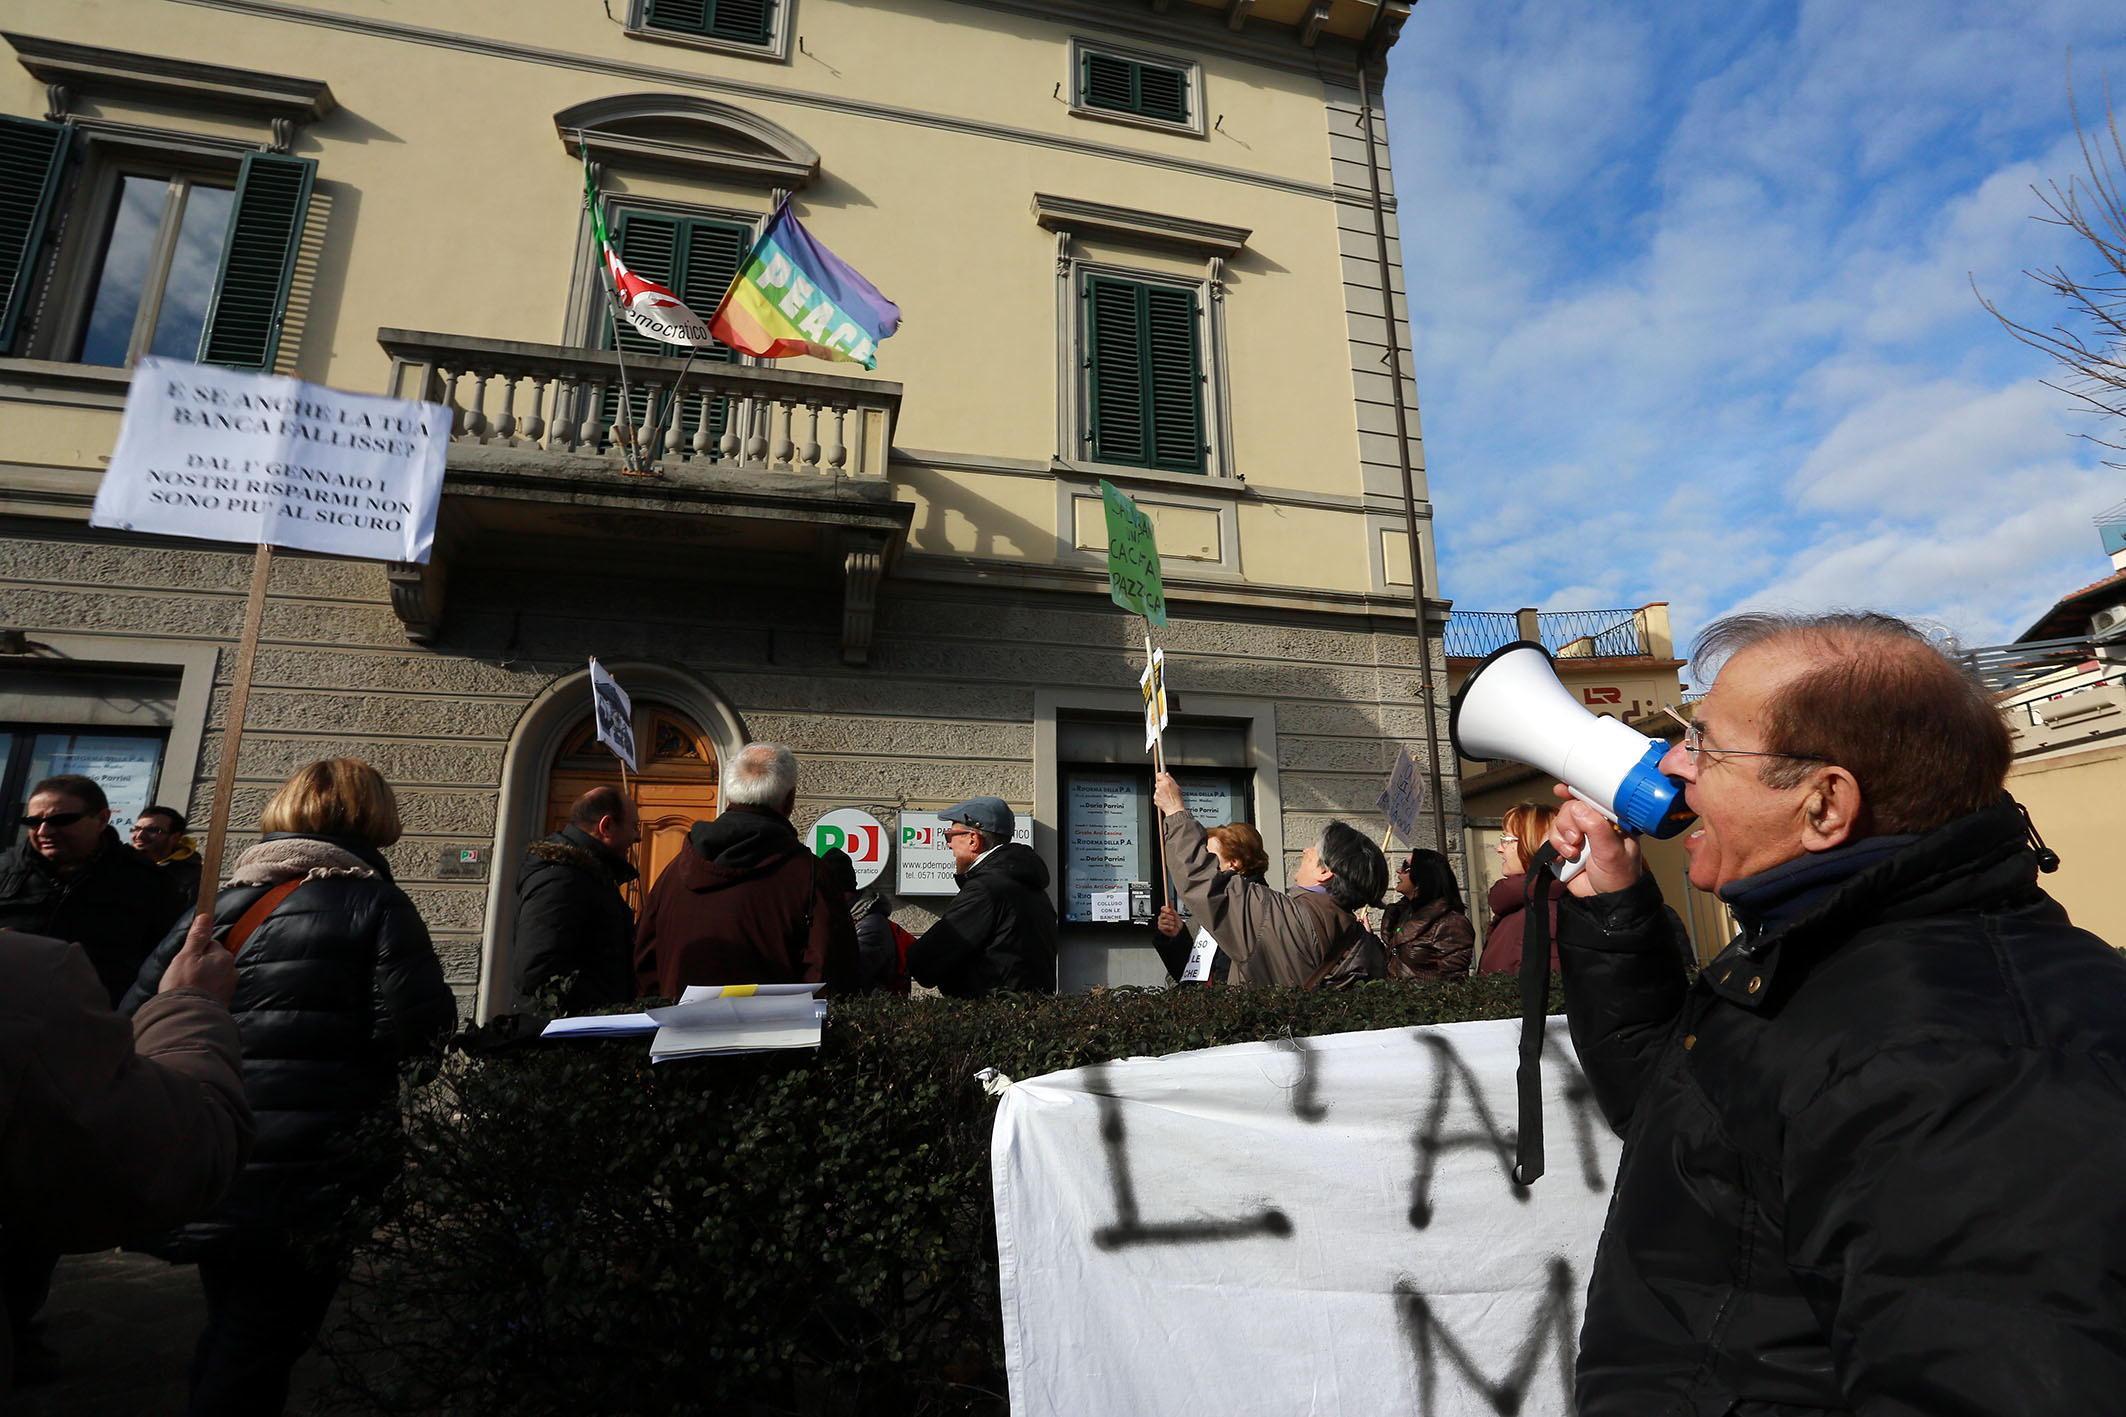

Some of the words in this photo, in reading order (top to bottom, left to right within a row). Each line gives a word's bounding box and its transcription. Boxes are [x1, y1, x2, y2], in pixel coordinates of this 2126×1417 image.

[629, 309, 708, 341] emocratico
[168, 380, 187, 399] E
[193, 386, 229, 404] SE
[234, 392, 331, 422] ANCHE
[339, 408, 372, 429] LA
[379, 414, 429, 438] TUA
[174, 406, 271, 435] BANCA
[280, 419, 415, 458] FALLISSE?
[147, 468, 238, 492] NOSTRI
[246, 480, 358, 509] RISPARMI
[366, 496, 412, 515] NON
[187, 453, 237, 473] DAL
[265, 461, 373, 493] GENNAIO
[149, 489, 220, 510] SONO
[228, 497, 273, 513] PIU'
[278, 504, 309, 520] AL
[315, 509, 402, 533] SICURO
